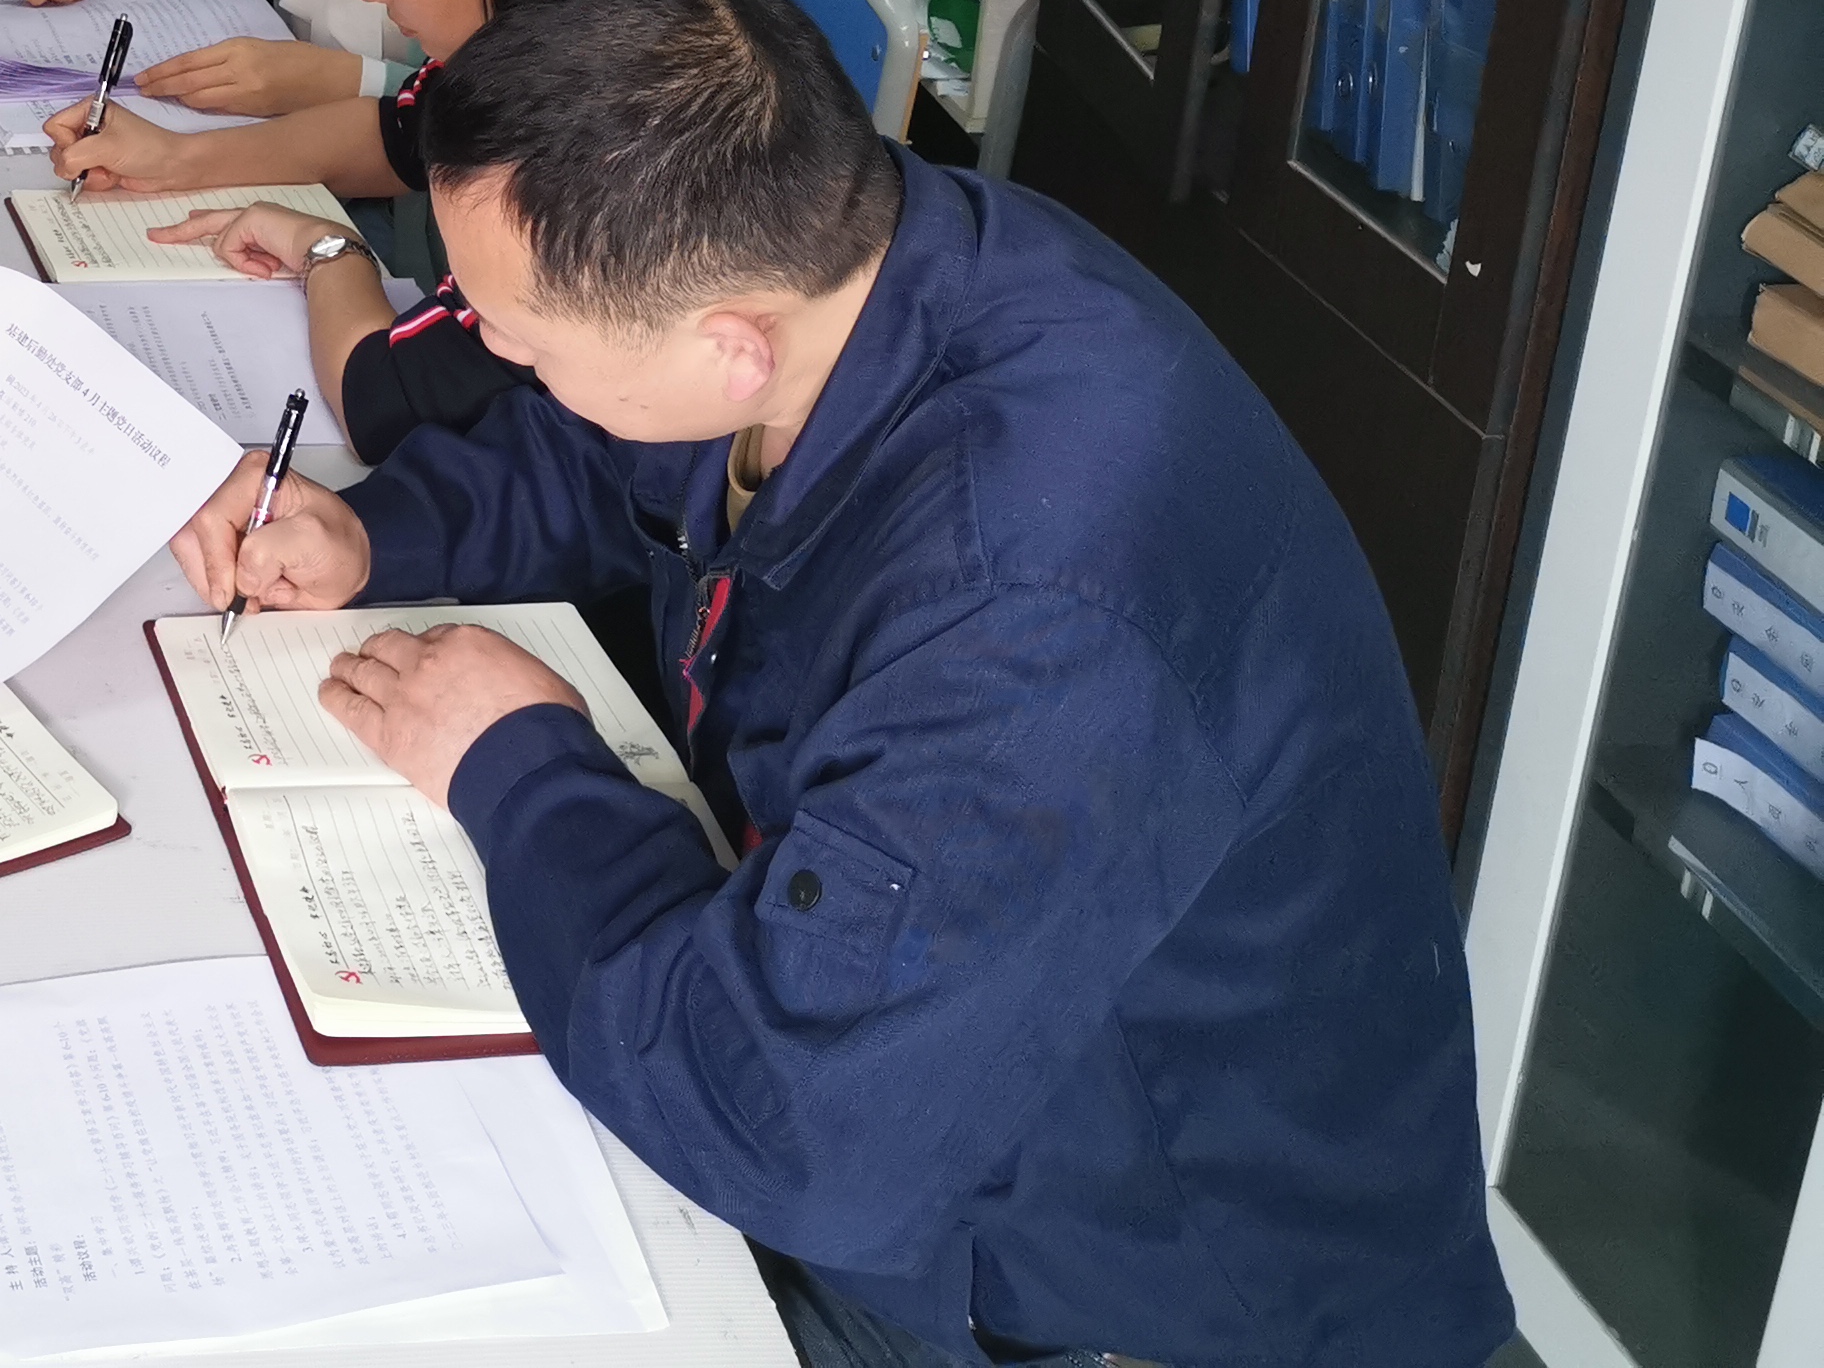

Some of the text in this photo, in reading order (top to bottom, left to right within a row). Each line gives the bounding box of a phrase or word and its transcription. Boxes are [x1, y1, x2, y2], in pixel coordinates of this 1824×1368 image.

[3, 321, 173, 470] 基建后勤处党支部4月主题党日活动议程
